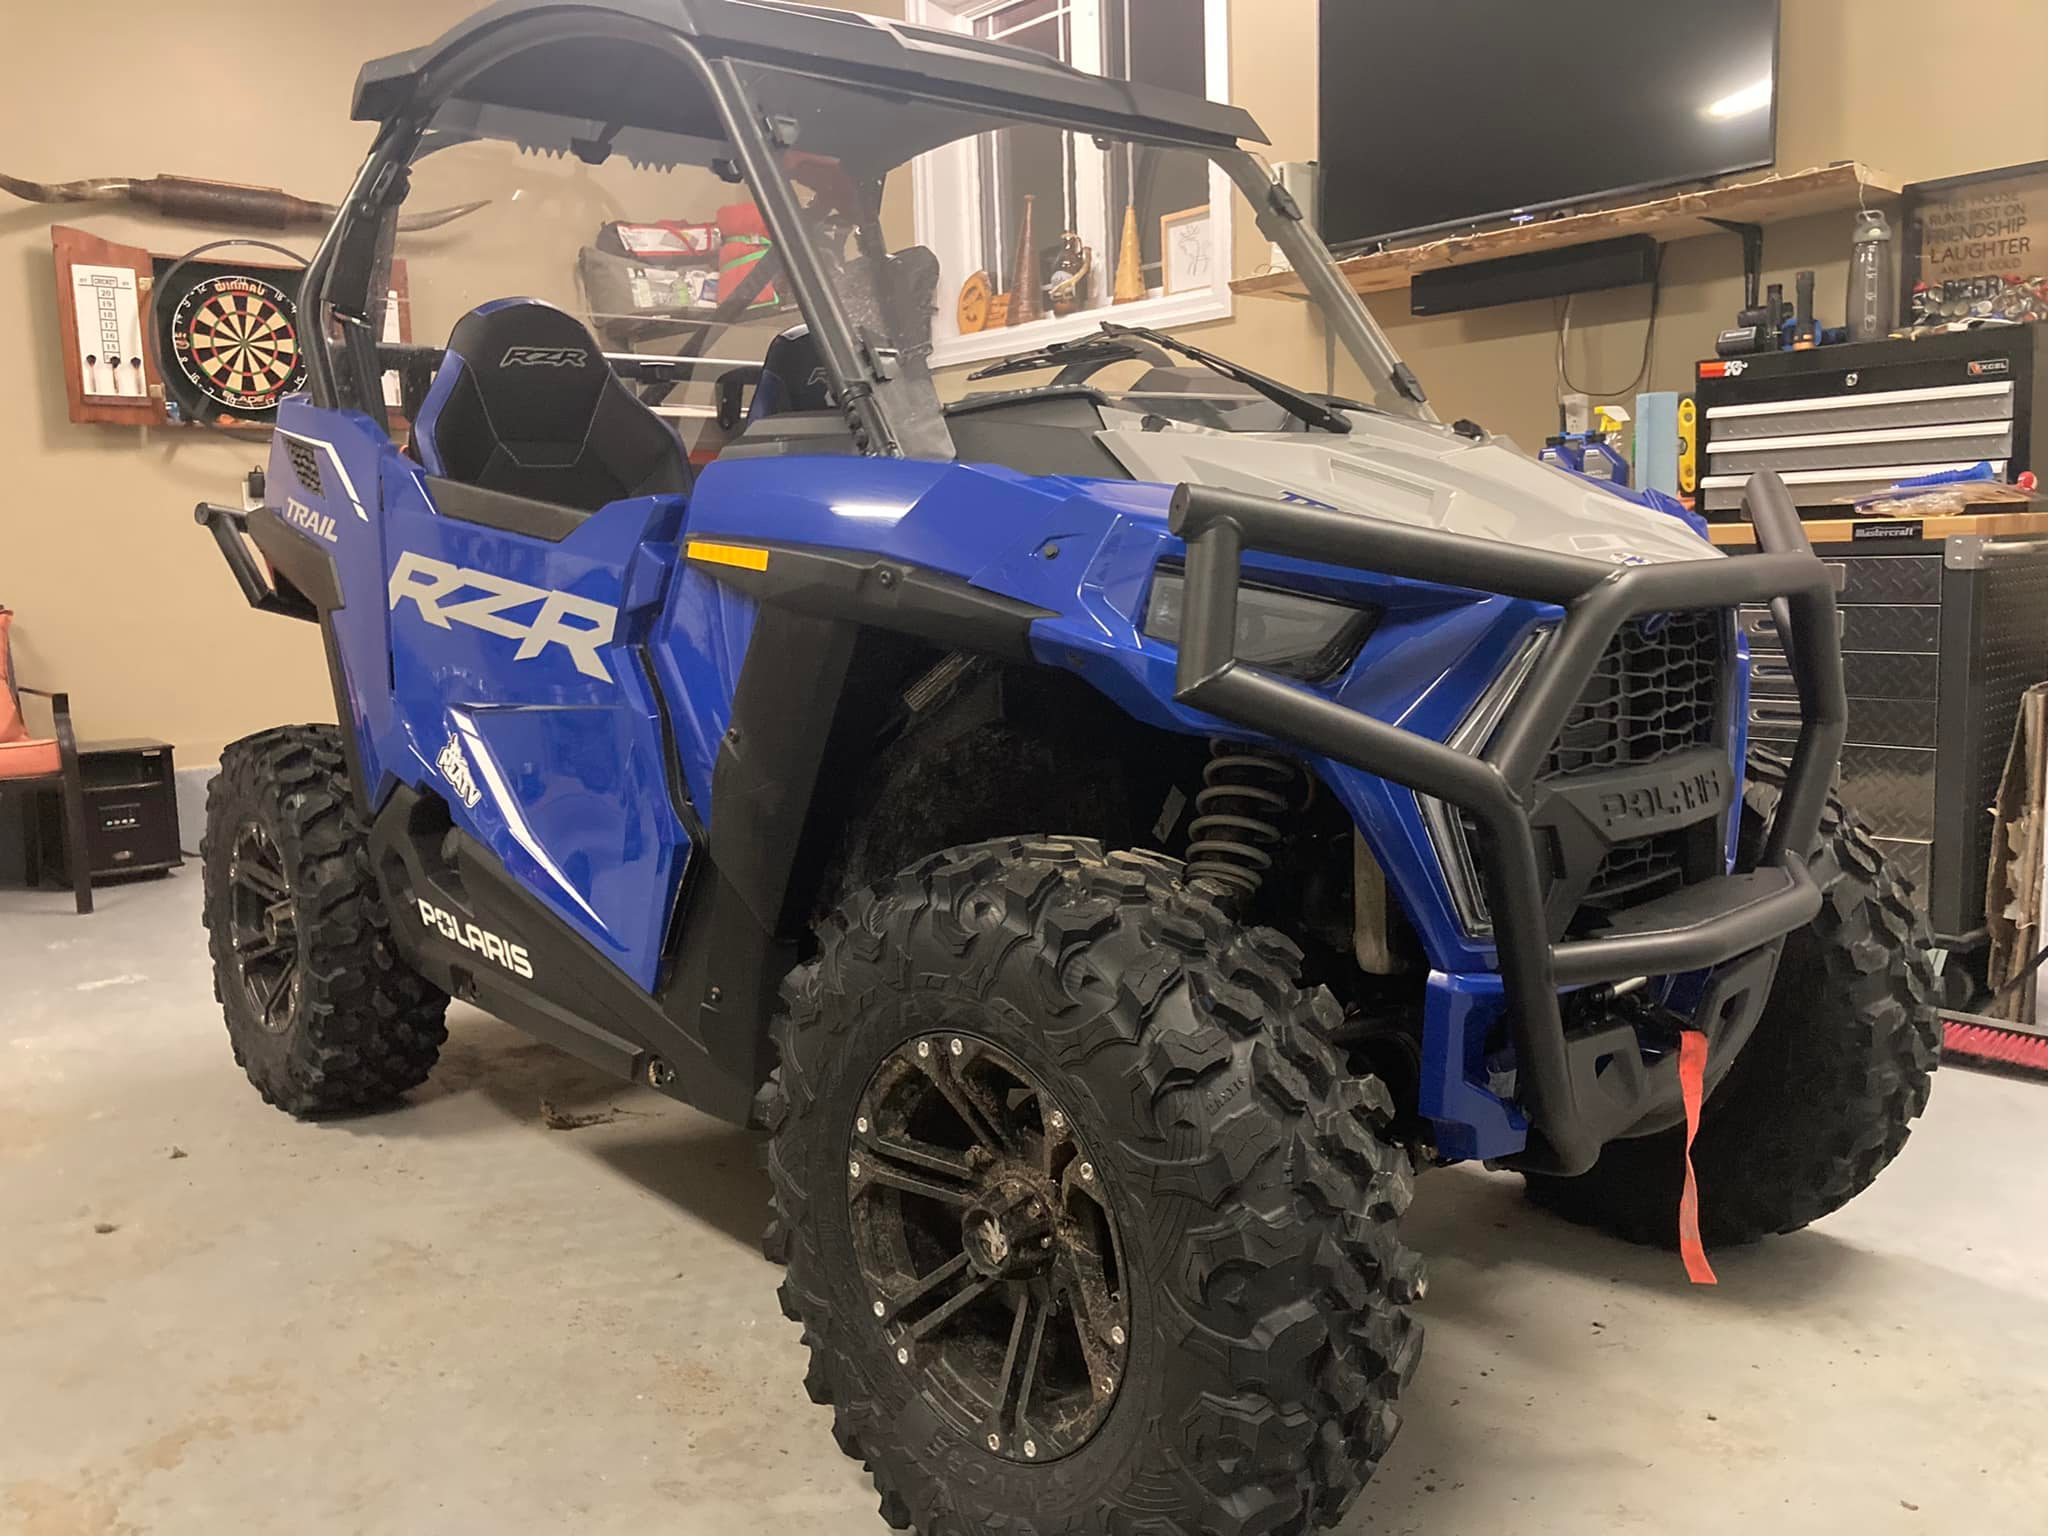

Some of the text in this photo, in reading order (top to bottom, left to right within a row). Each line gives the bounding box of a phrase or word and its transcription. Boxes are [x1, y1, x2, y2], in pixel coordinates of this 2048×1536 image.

[2004, 203, 2025, 216] ON
[1927, 216, 2027, 245] FRIENDSHIP
[1931, 237, 2030, 264] LAUGHTER
[500, 347, 588, 368] RZR
[287, 497, 338, 542] TRAIL
[388, 551, 618, 684] RZR
[1600, 769, 1720, 827] POLARIS
[418, 898, 534, 980] POLARIS
